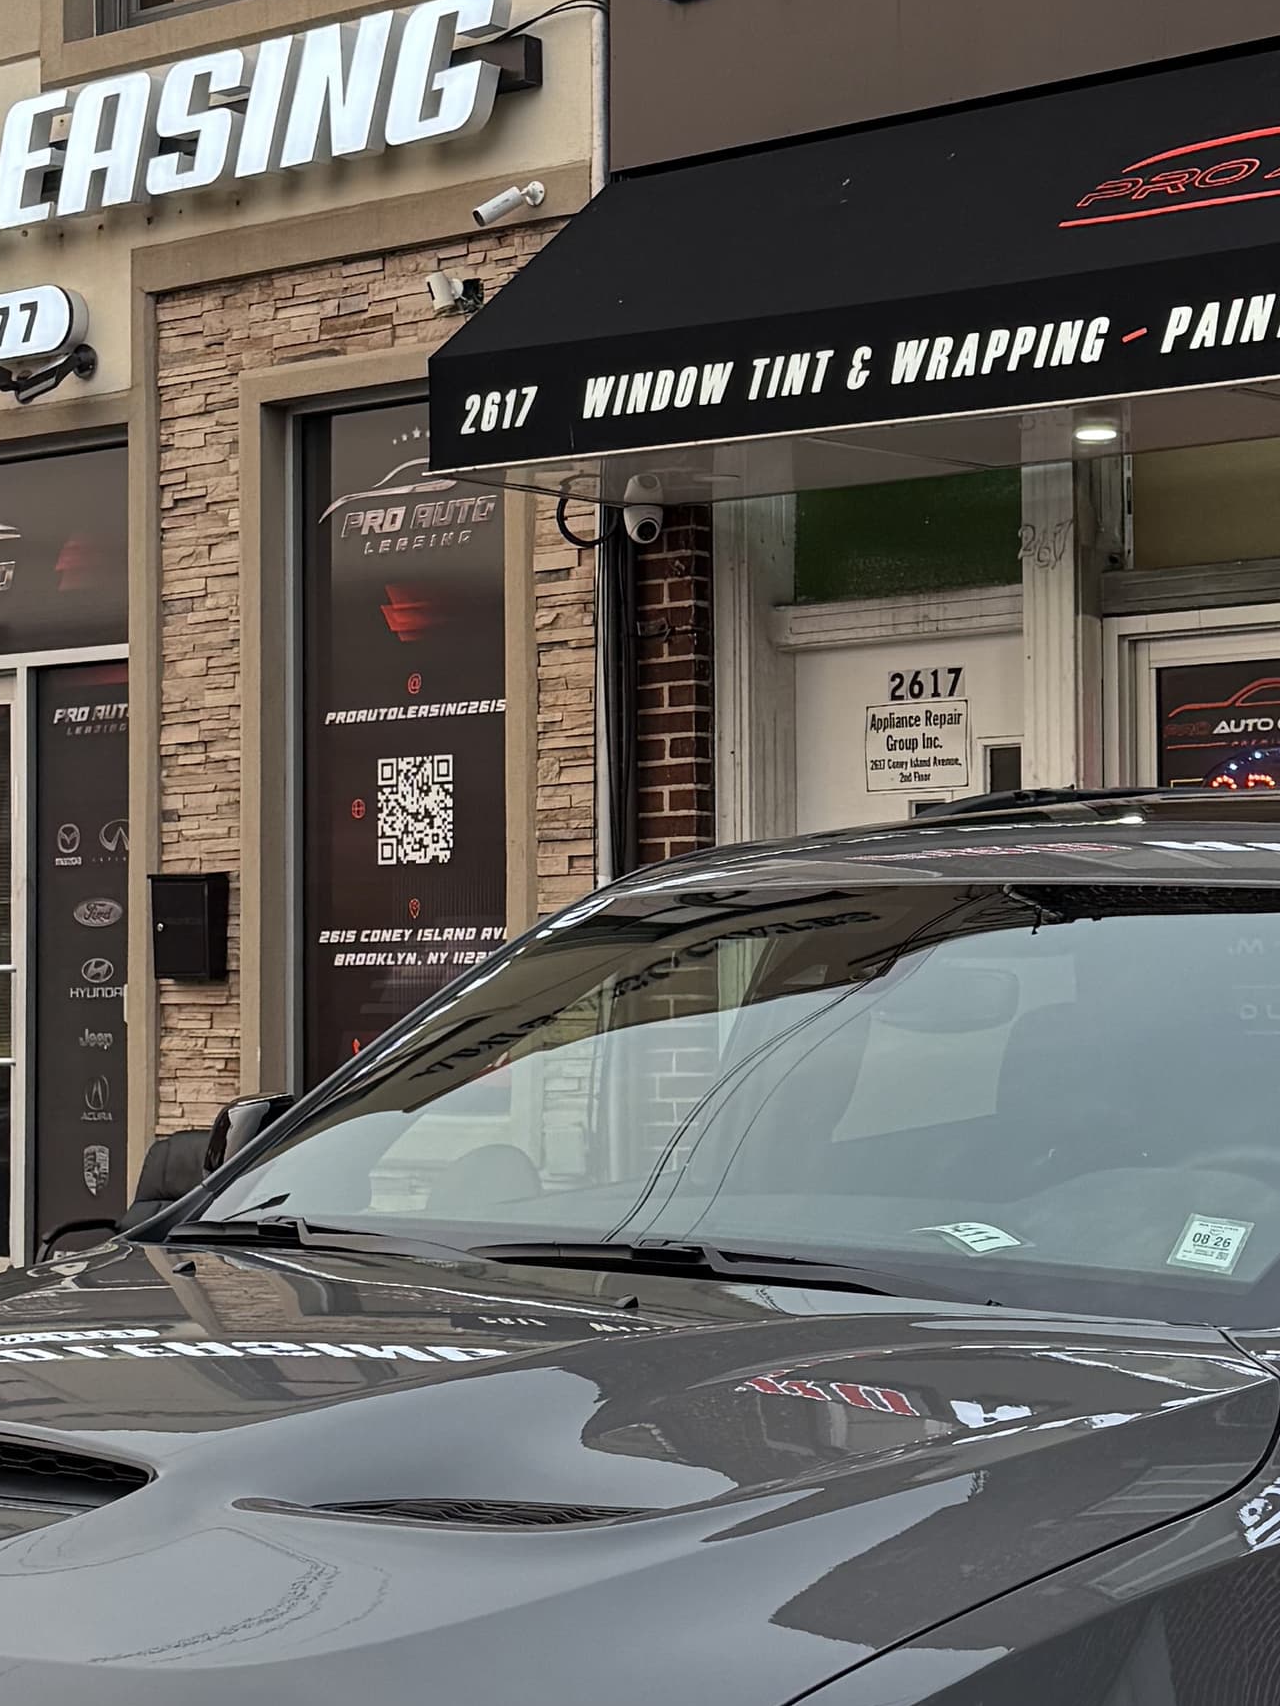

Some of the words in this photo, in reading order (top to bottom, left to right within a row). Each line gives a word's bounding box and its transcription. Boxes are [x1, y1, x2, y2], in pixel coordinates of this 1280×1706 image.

[1076, 155, 1260, 209] PRO
[582, 355, 741, 421] WINDOW
[748, 347, 836, 396] TINT
[846, 344, 873, 391] &
[890, 315, 1110, 387] WRAPPING
[460, 386, 538, 435] 2617
[340, 505, 408, 539] PRO
[409, 494, 499, 530] AUTO
[363, 529, 473, 555] LEASING
[889, 666, 964, 702] 2617
[53, 705, 90, 725] PRO
[92, 702, 129, 722] AUT
[324, 697, 507, 726] PROAUTOLEASING2615
[869, 712, 922, 734] Appliance
[924, 708, 964, 729] Repair
[1212, 717, 1274, 735] AUTO
[886, 734, 919, 753] Group
[922, 732, 944, 750] Inc.
[83, 902, 114, 922] Ford
[319, 930, 357, 944] 2615
[360, 929, 414, 943] CONEY
[417, 927, 478, 942] ISLAND
[427, 951, 449, 965] NY
[452, 950, 493, 965] 1122
[78, 1027, 114, 1051] Jeep
[80, 1110, 113, 1122] ACURA
[1192, 1232, 1211, 1245] 08
[1213, 1236, 1233, 1248] 26
